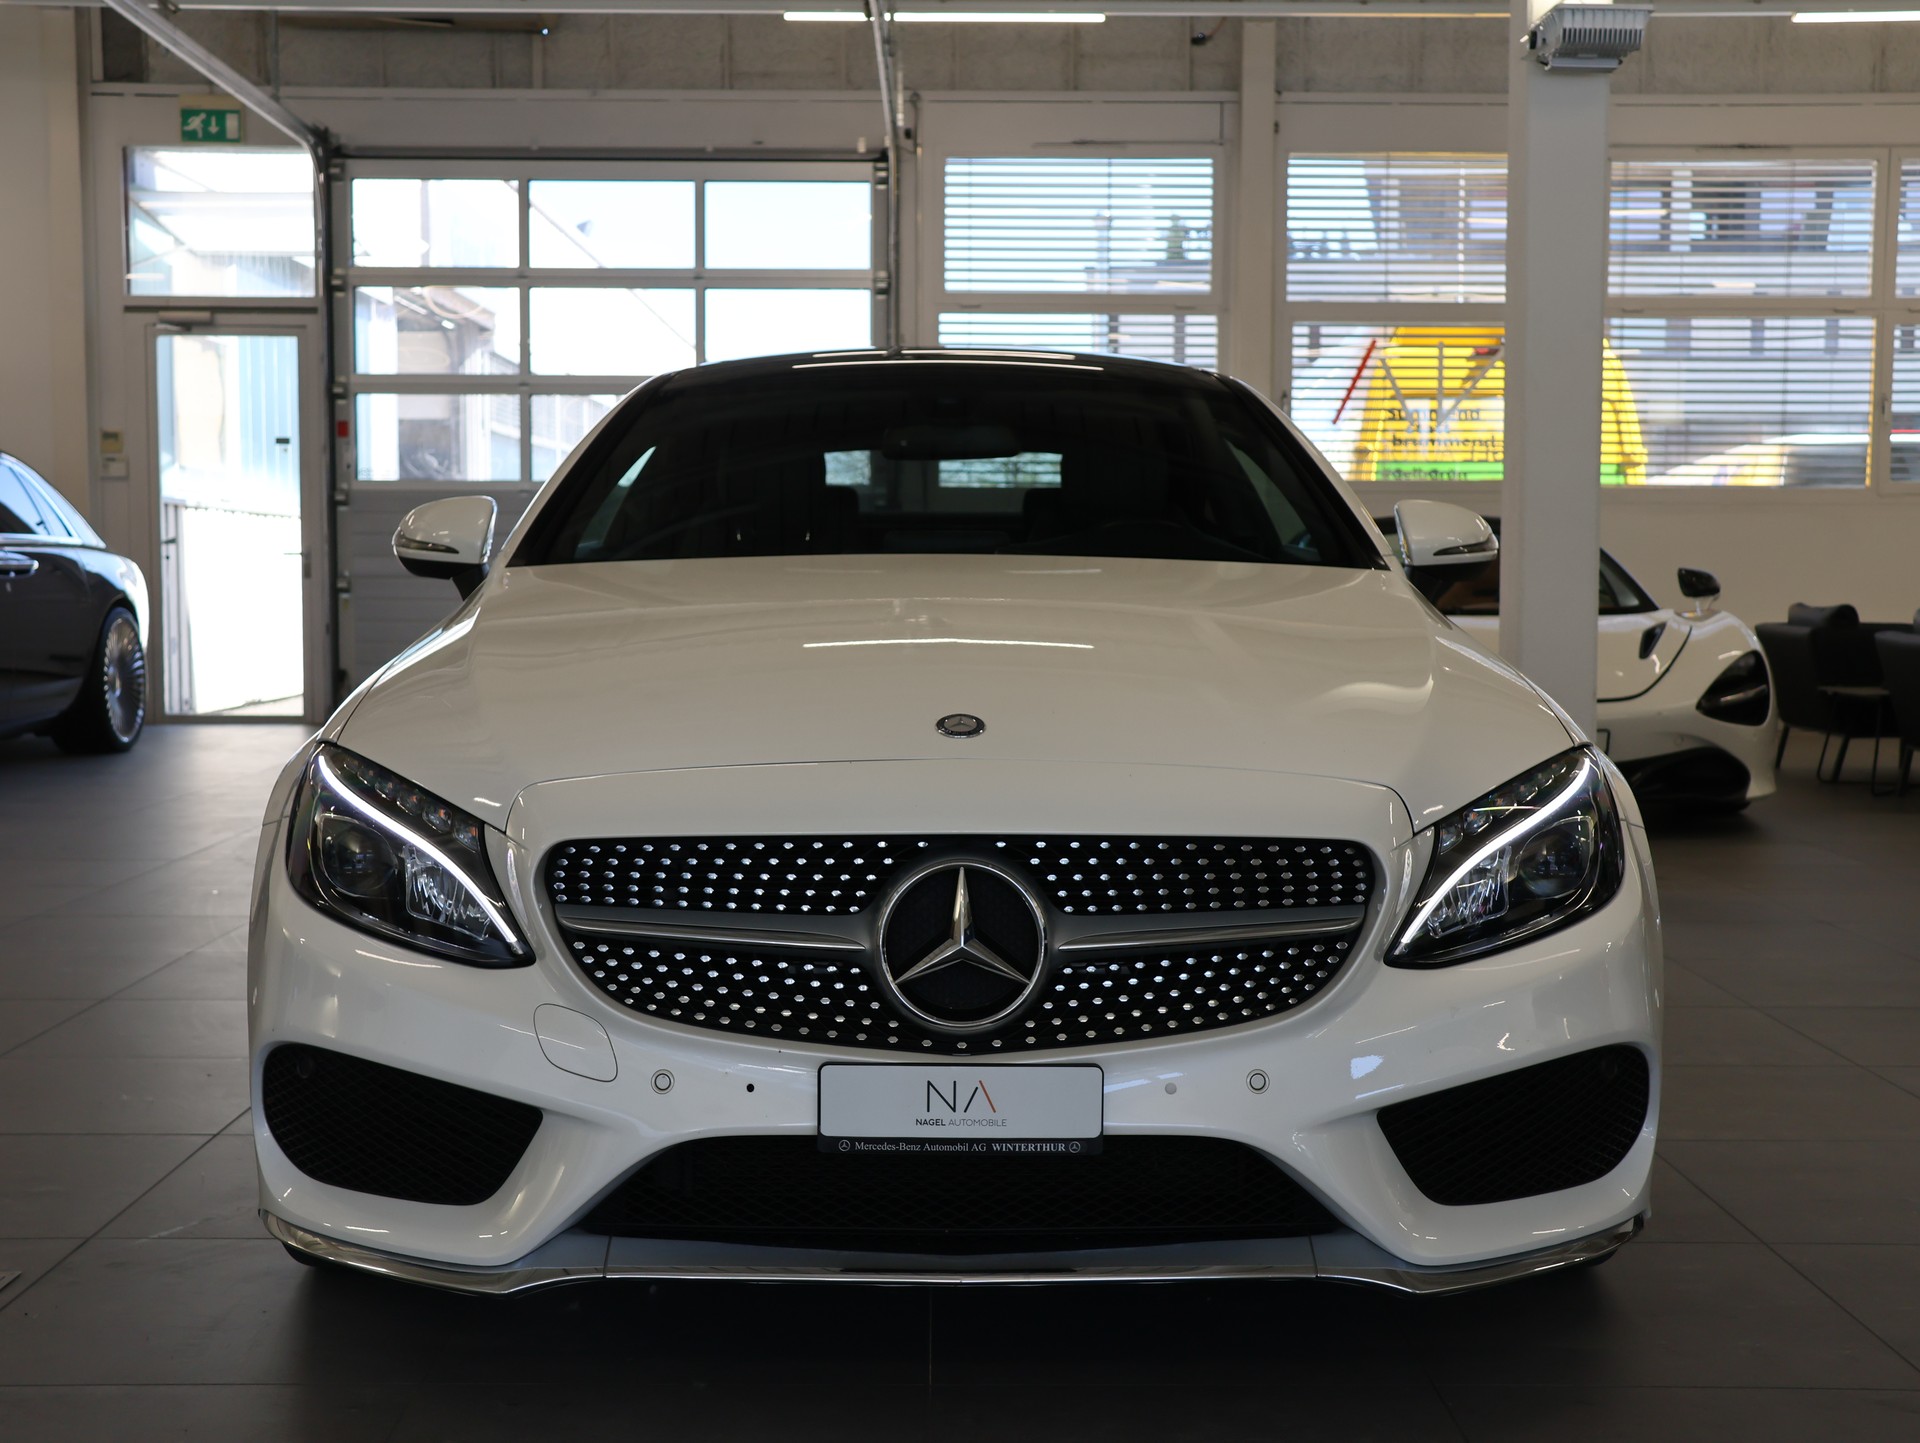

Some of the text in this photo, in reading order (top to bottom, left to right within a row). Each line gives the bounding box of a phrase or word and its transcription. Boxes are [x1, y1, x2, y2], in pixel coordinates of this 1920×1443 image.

[927, 1080, 996, 1113] NA
[915, 1118, 1007, 1127] NAGEL AUTOMOBILE
[855, 1141, 1066, 1152] Mercedes-Benz Automobil AG WINTERTHUR
